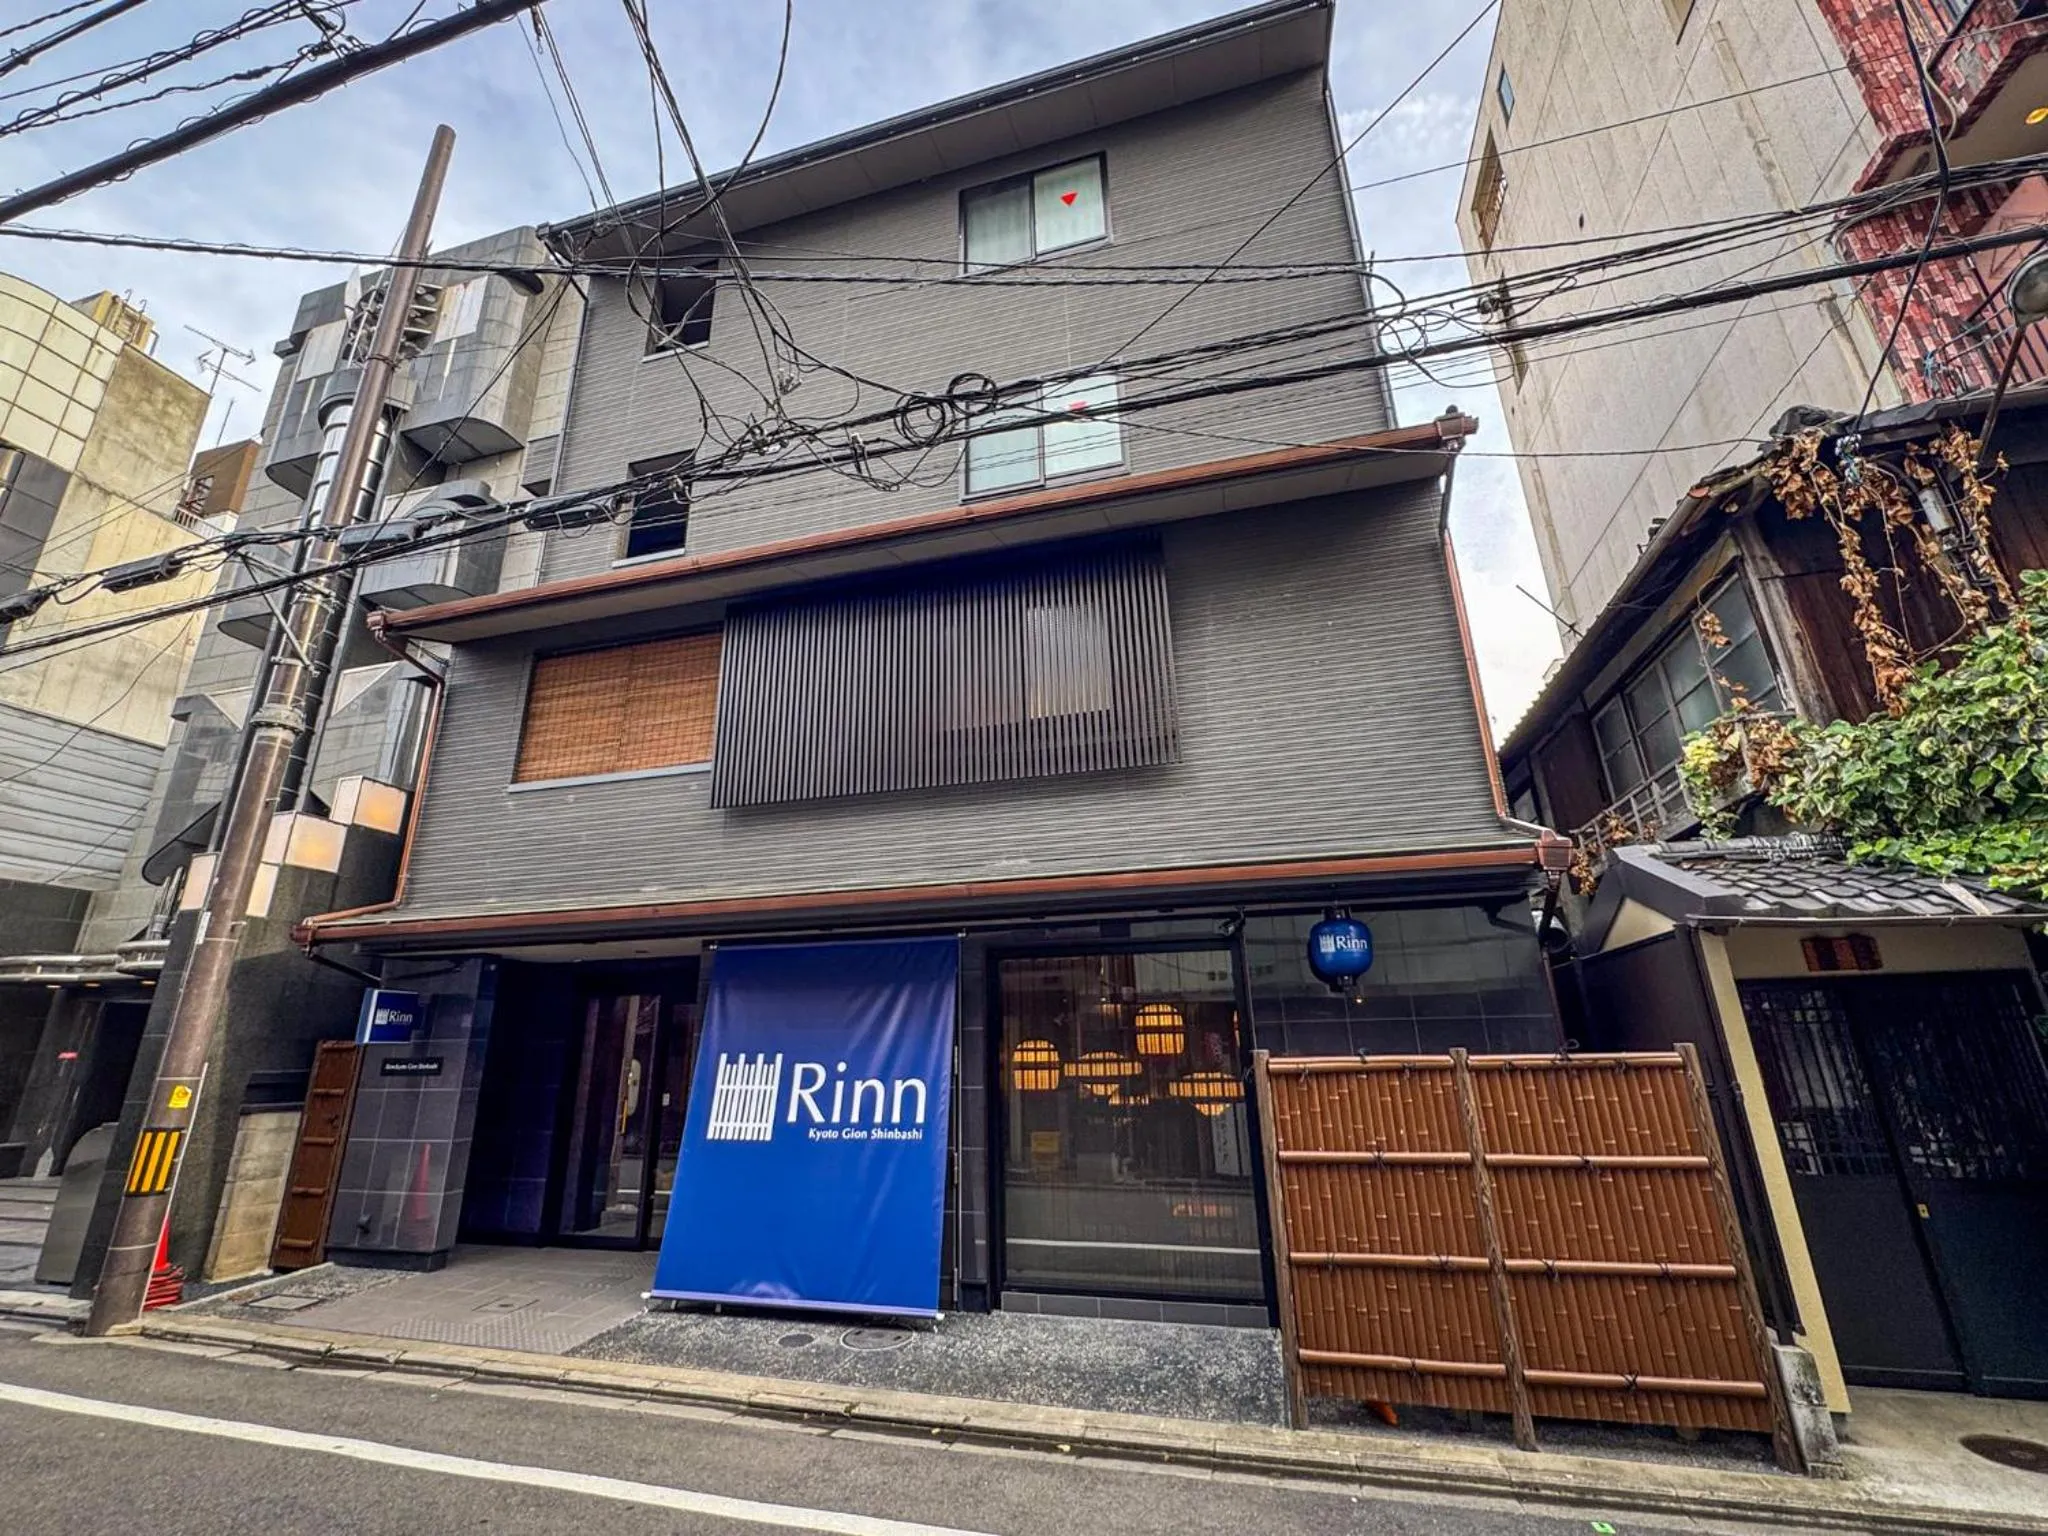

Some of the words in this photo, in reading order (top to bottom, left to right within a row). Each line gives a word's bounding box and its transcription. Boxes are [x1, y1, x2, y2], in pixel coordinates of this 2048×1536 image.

[1336, 935, 1368, 950] Rinn
[388, 1010, 413, 1023] Rinn
[787, 1061, 927, 1124] Rinn
[808, 1127, 839, 1142] Kyoto
[842, 1127, 868, 1140] Gion
[870, 1127, 923, 1140] Shinbashi
